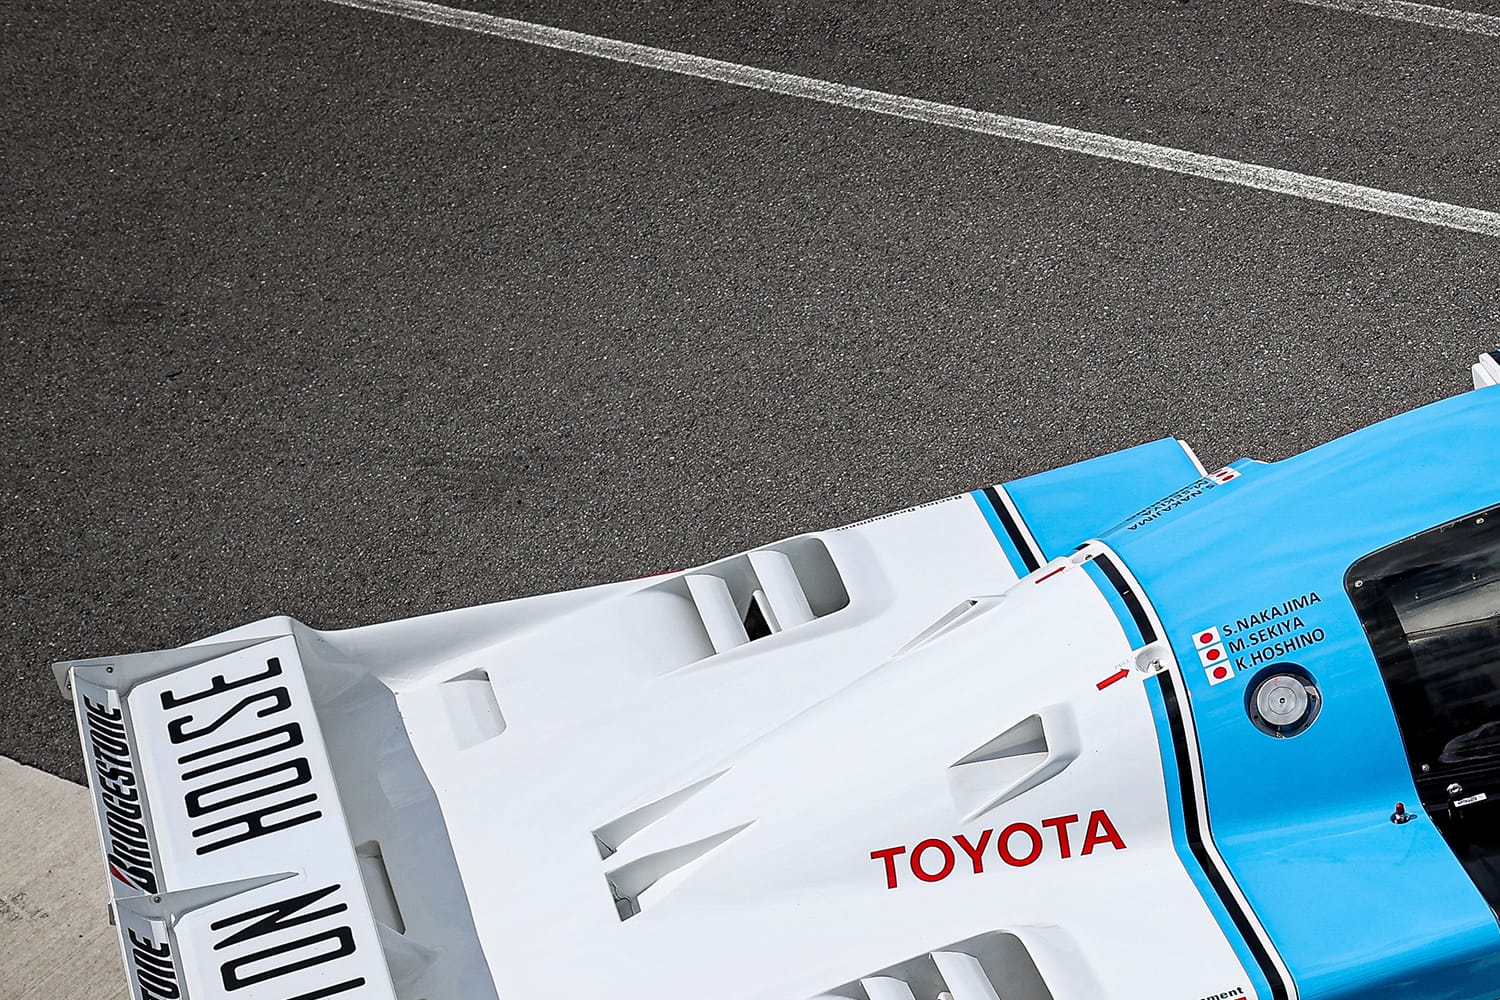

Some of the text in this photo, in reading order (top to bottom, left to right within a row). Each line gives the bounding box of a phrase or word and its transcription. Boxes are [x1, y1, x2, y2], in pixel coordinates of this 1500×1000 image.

[1223, 592, 1321, 637] S.NAKAJIMA
[1229, 617, 1305, 653] M.SEKIYA
[1236, 628, 1325, 671] K.HOSHINO
[161, 657, 323, 856] HOUSE
[82, 696, 157, 894] BRIDGESTONE
[870, 809, 1127, 890] TOYOTA
